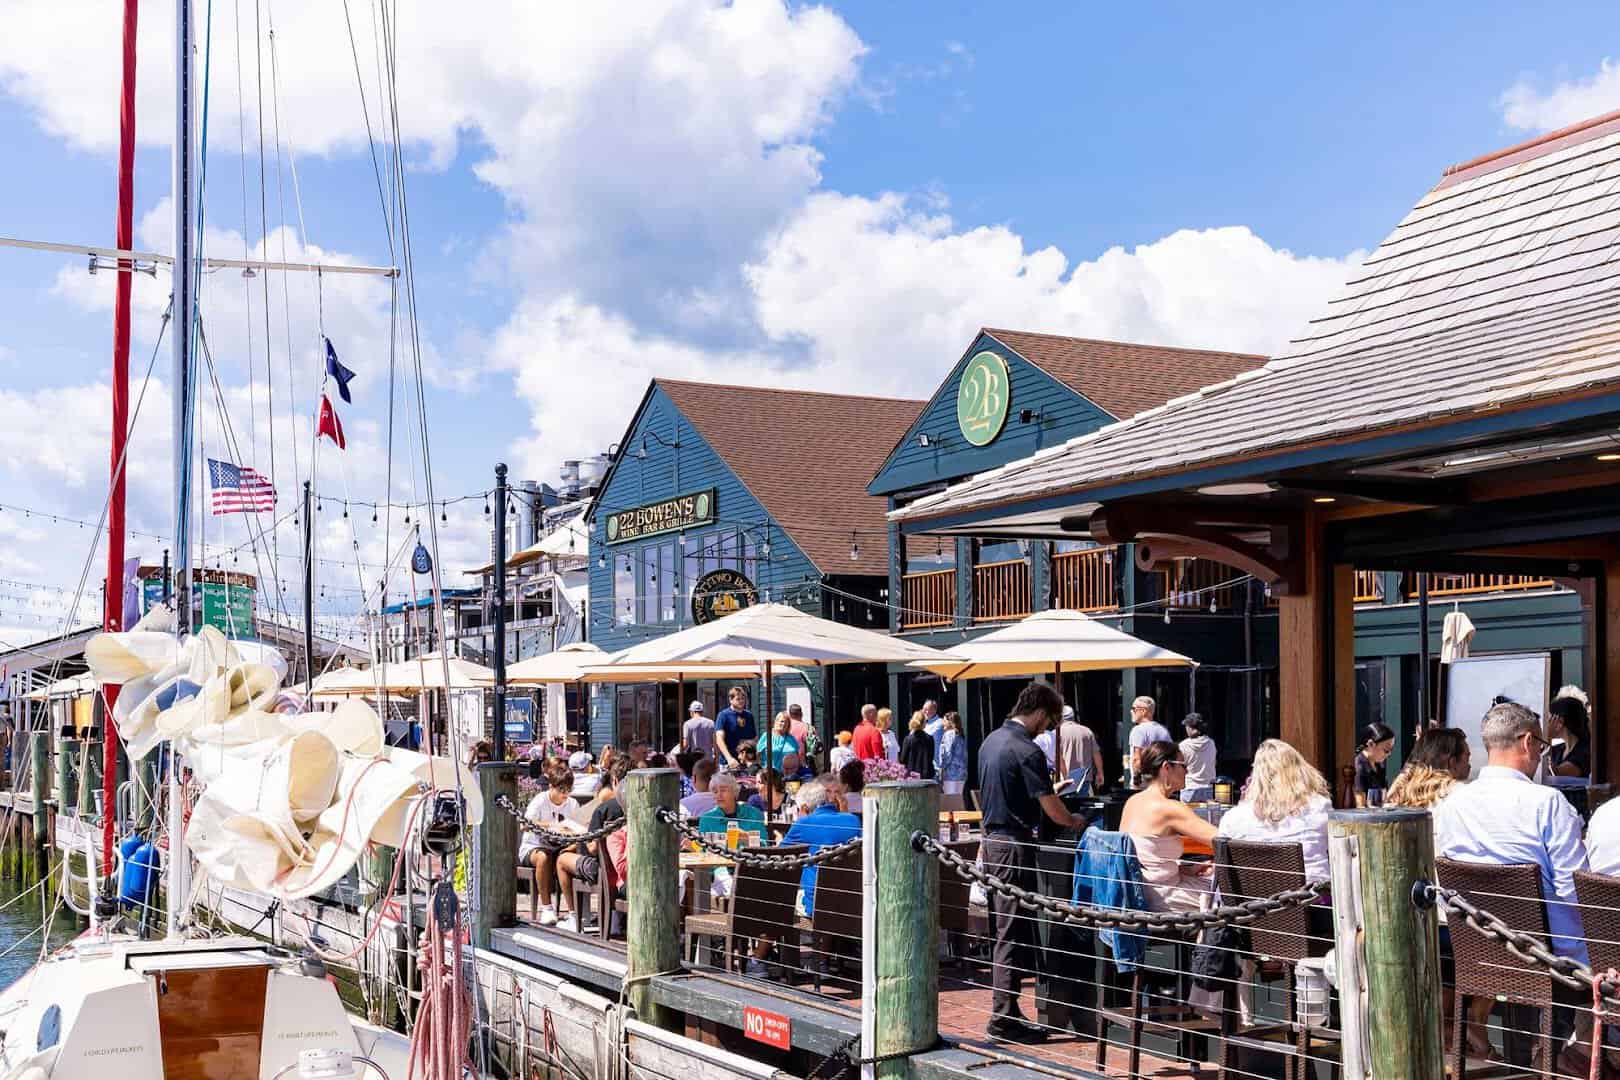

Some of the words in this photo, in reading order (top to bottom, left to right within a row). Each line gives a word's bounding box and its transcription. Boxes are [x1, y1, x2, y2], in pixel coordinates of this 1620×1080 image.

[619, 511, 634, 529] 22
[636, 497, 694, 526] BOWEN'S
[621, 527, 639, 538] WINE
[643, 522, 658, 534] BAR
[666, 514, 695, 528] GRILLE
[746, 1012, 764, 1035] NO
